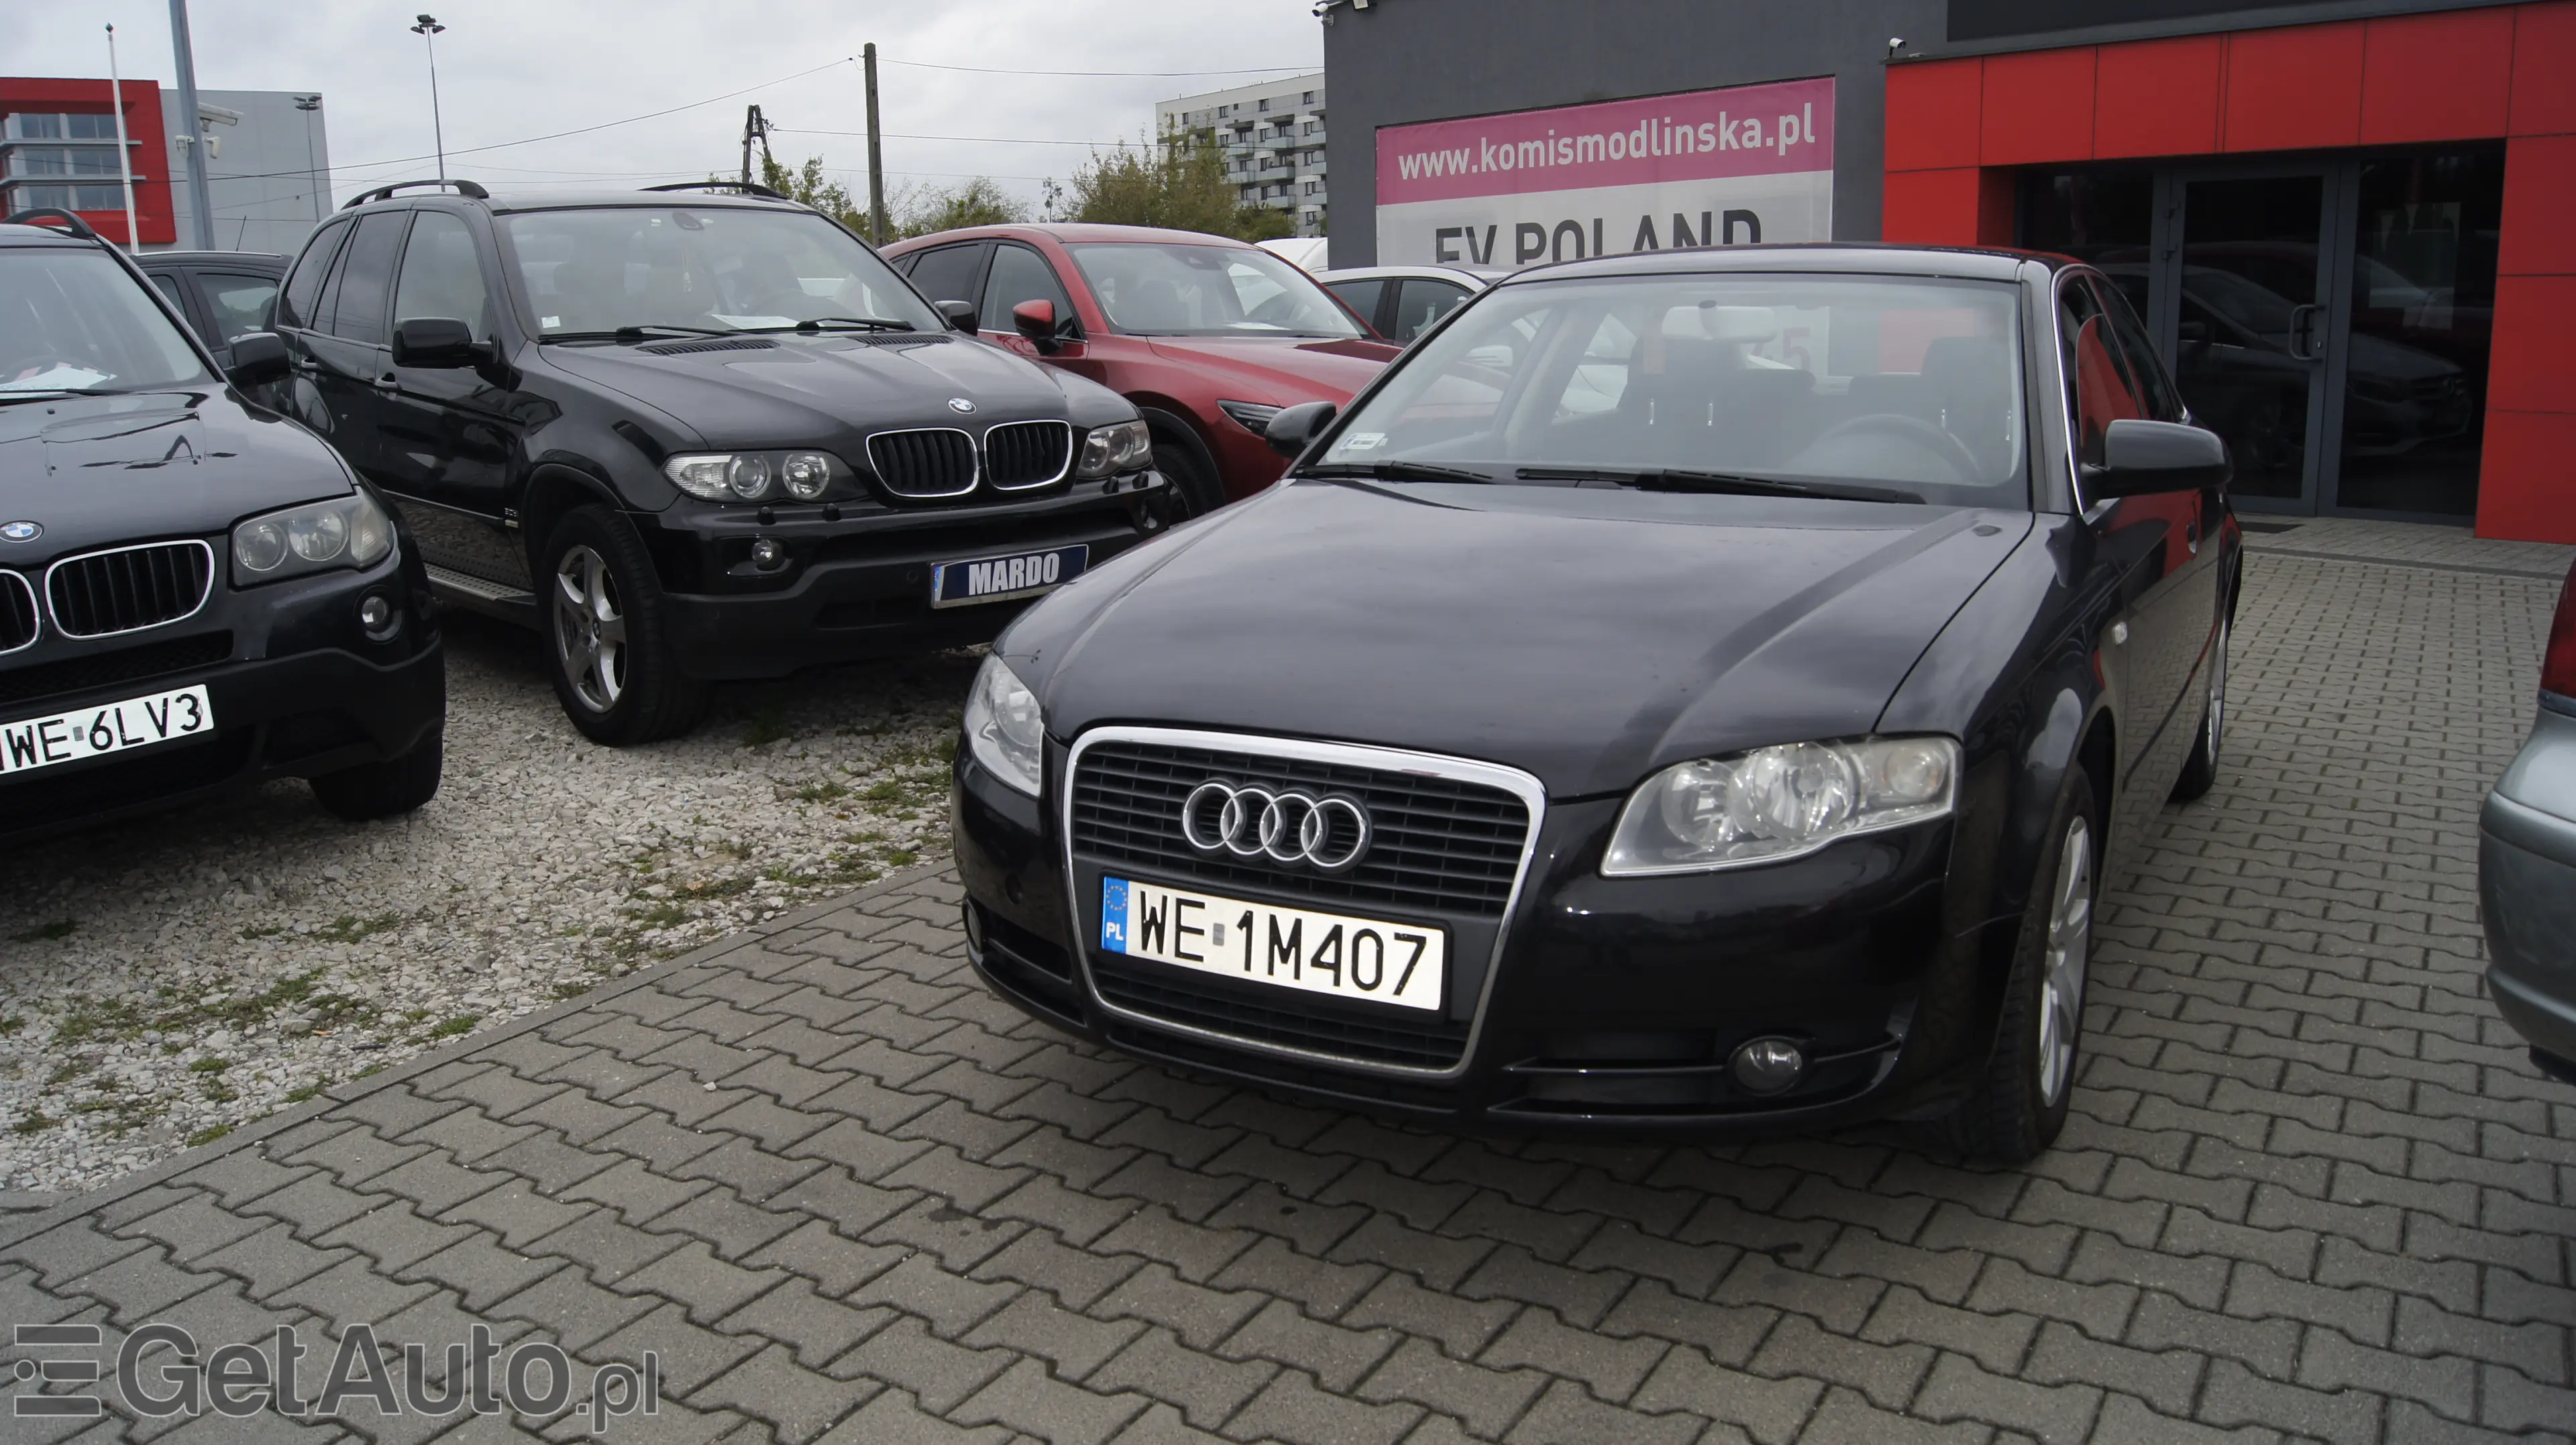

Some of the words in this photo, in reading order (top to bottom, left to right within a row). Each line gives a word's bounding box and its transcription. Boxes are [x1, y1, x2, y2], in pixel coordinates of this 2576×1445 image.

[1398, 103, 1815, 180] www.komismodlinska.pl
[969, 553, 1060, 596] MARDO
[0, 718, 72, 771] WE
[89, 693, 204, 751] 6LV3
[1106, 922, 1124, 941] PL
[1140, 890, 1205, 962] WE
[1236, 910, 1427, 996] 1M407
